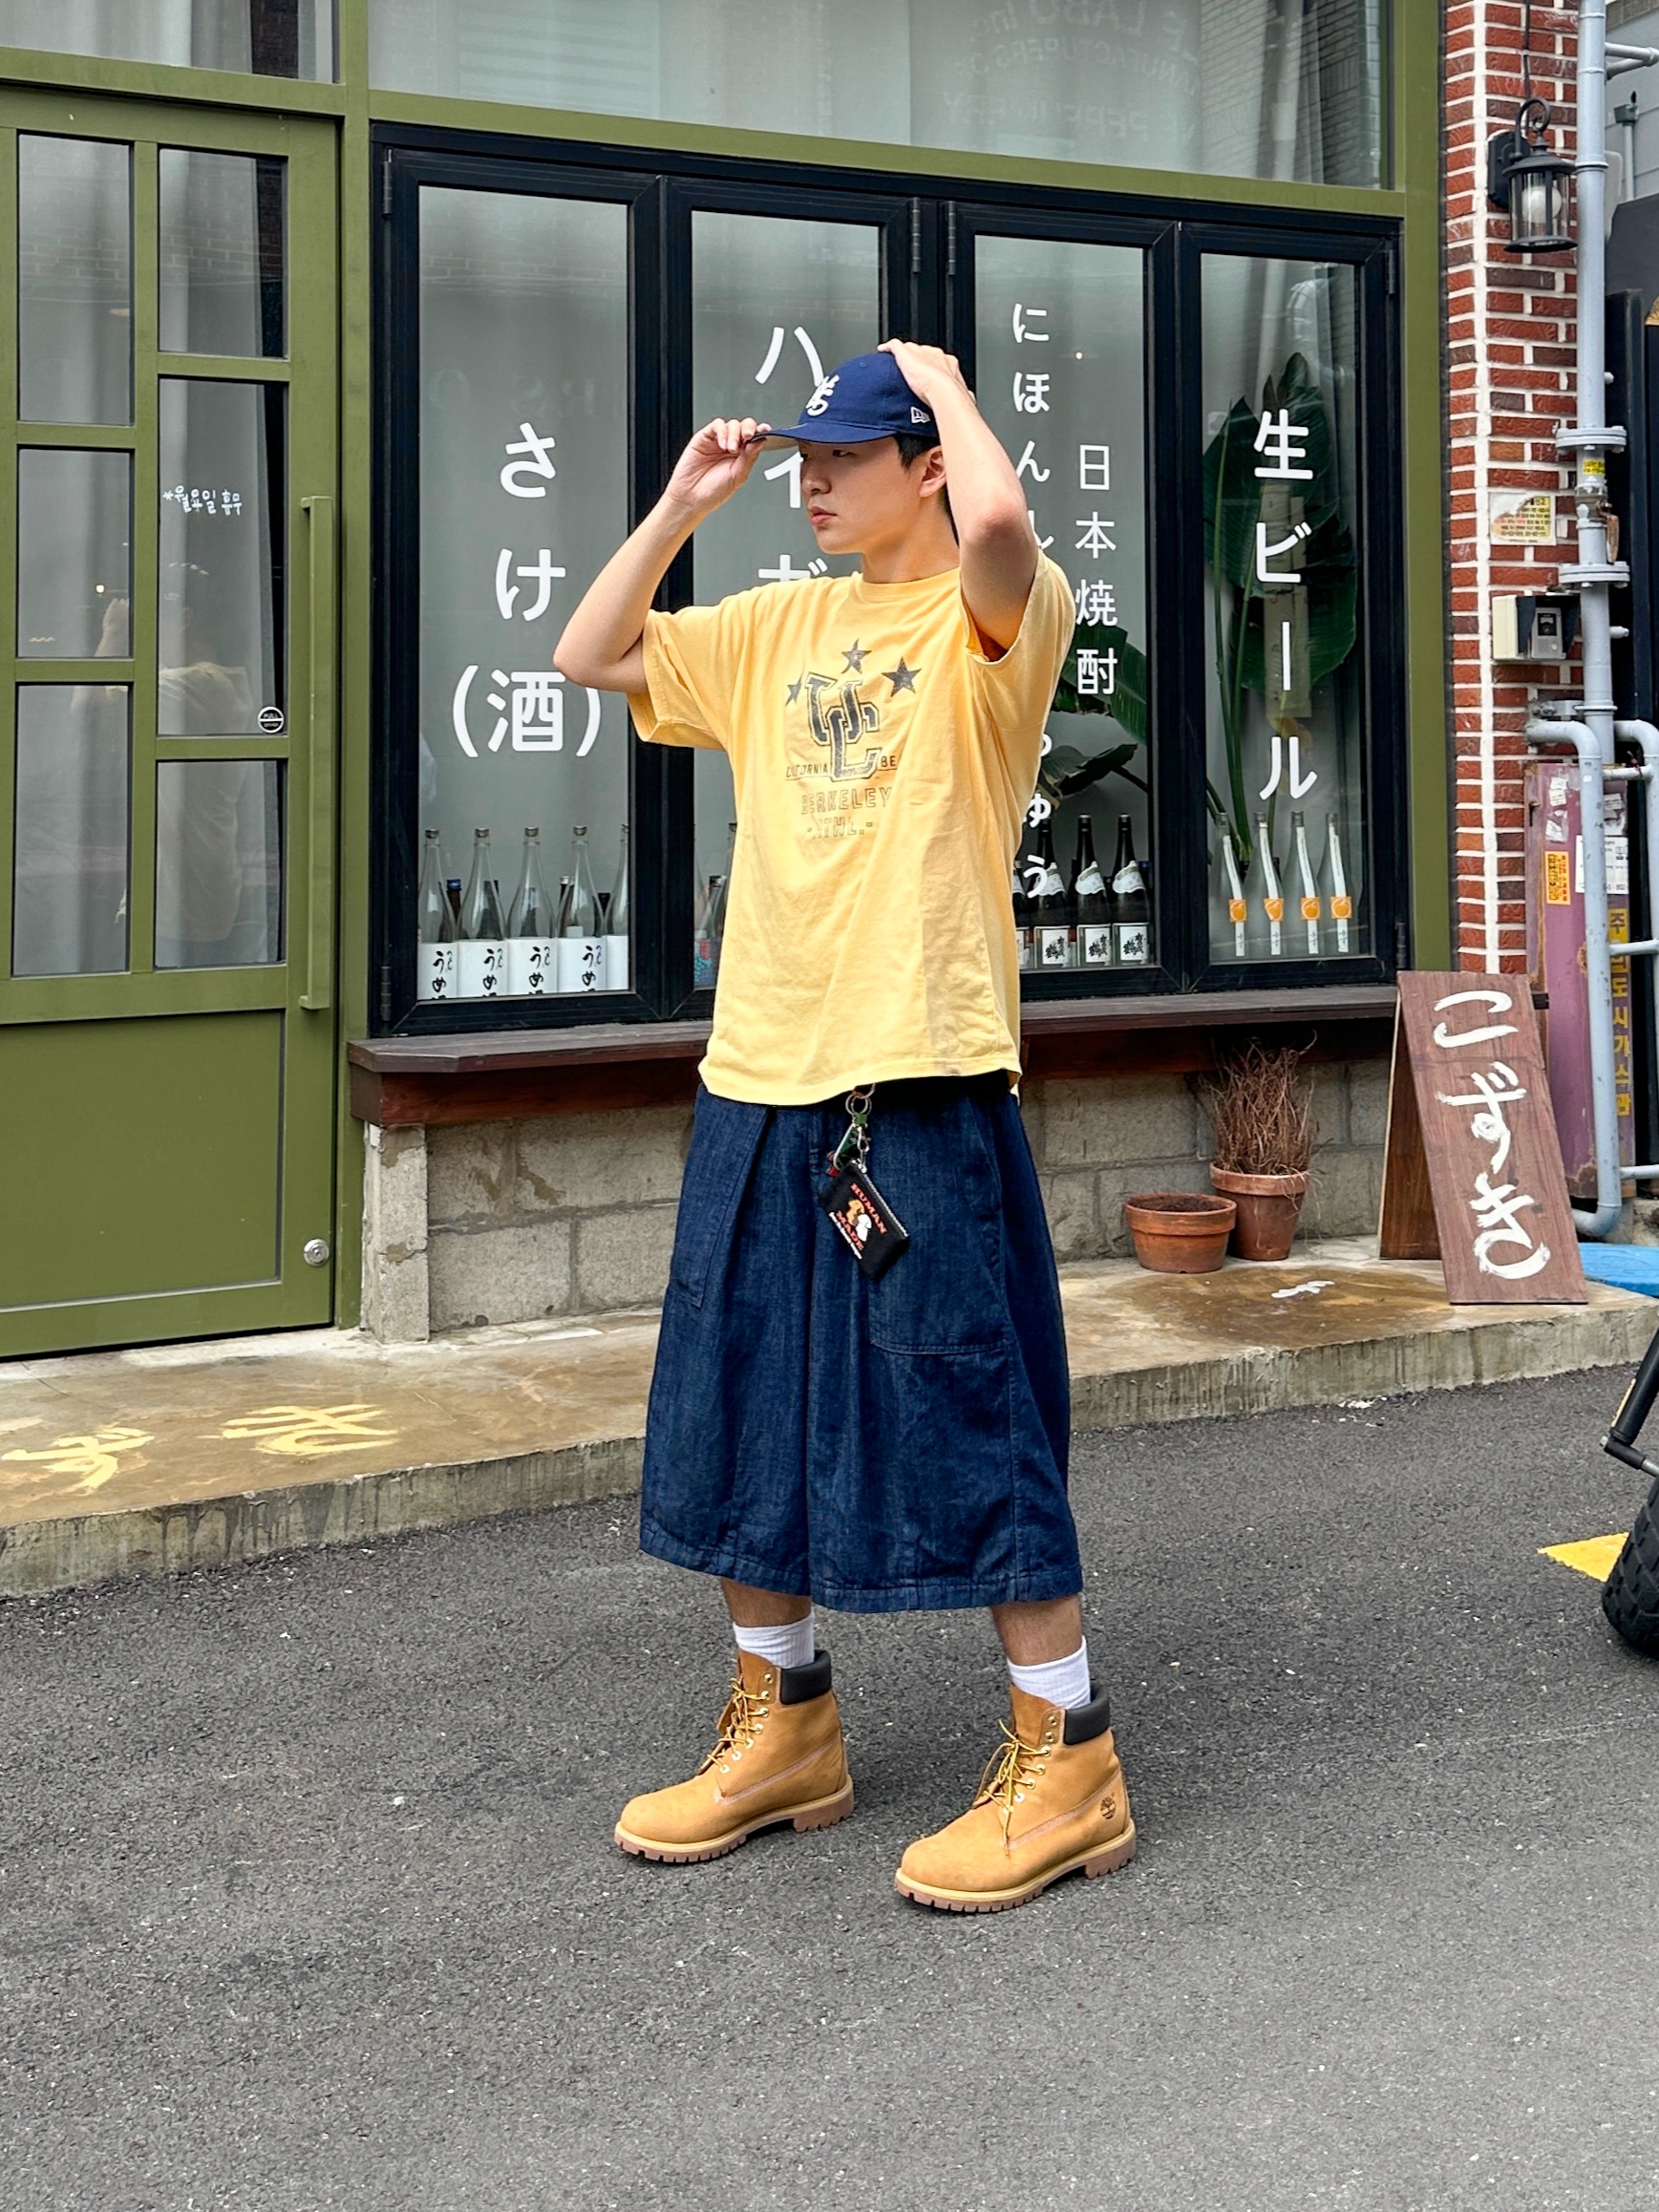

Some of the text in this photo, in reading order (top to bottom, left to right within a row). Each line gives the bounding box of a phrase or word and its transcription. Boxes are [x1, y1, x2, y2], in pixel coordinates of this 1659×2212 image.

[221, 489, 243, 516] 휴무
[1074, 444, 1117, 695] 日本焼酎
[1254, 409, 1317, 800] 生ビール
[800, 787, 892, 815] BERKELEY
[432, 950, 447, 998] うめ
[482, 948, 497, 996] うめ
[528, 946, 543, 993] うめ
[582, 945, 596, 990] うめ
[1434, 989, 1551, 1279] こずき
[836, 1210, 864, 1251] MADE
[850, 1182, 888, 1235] HUMAN
